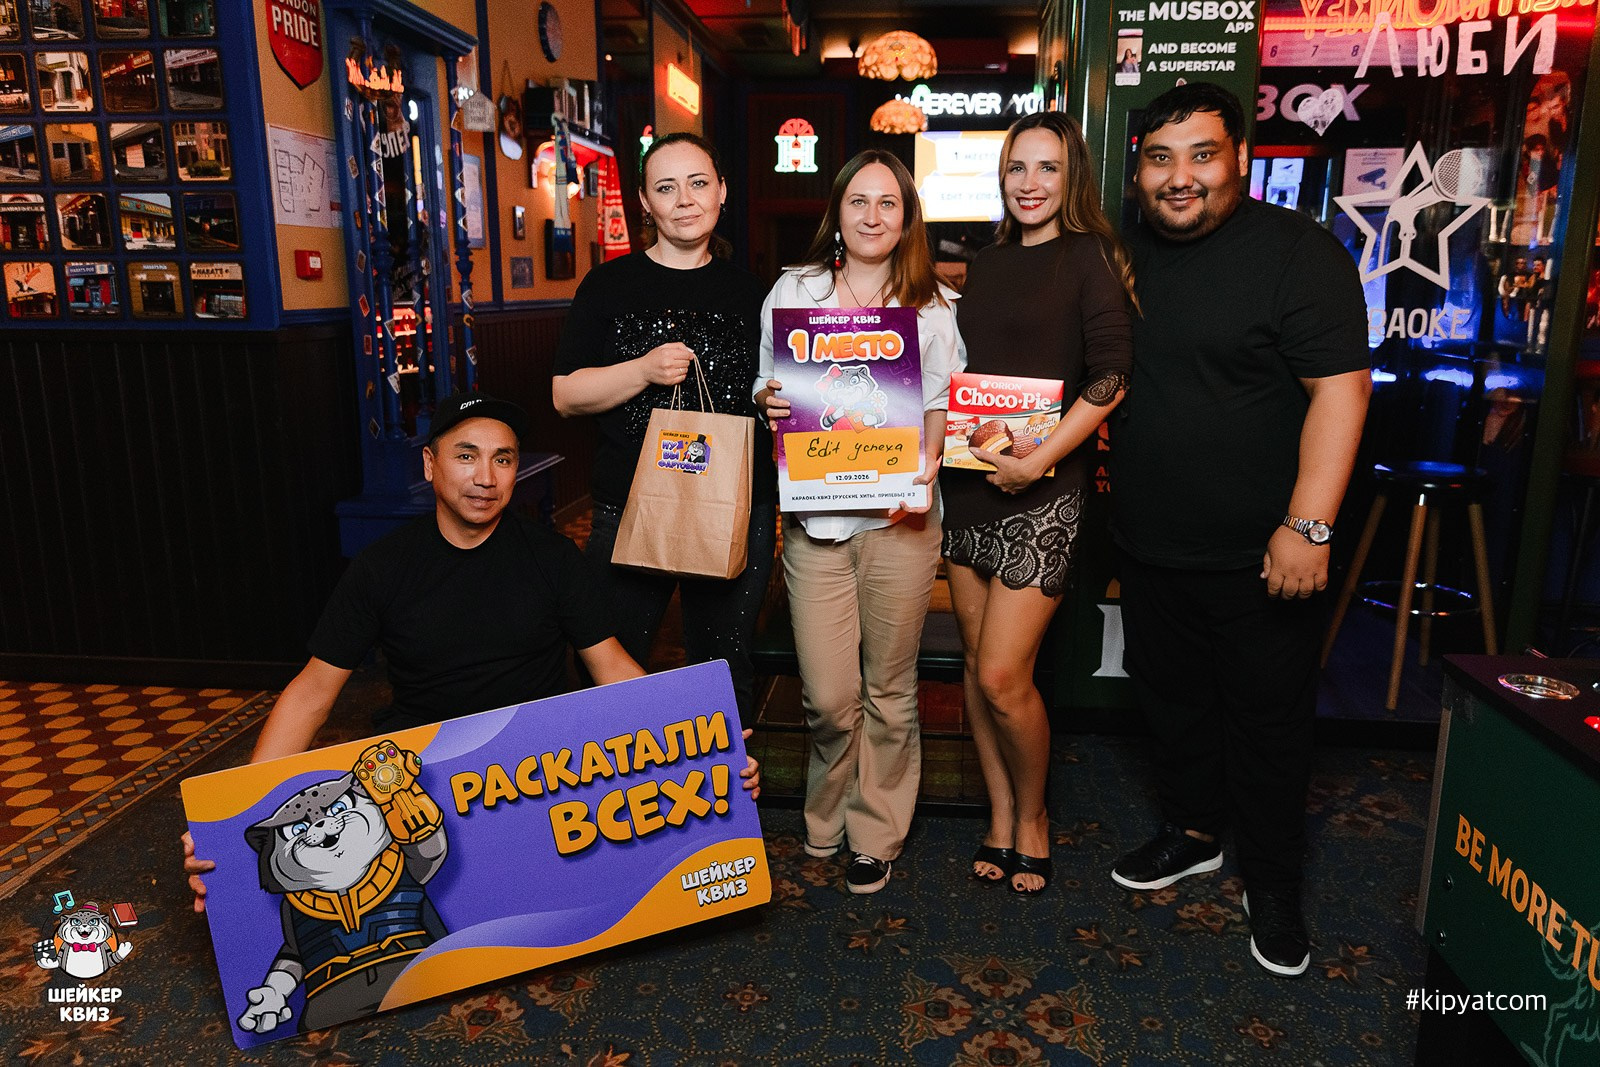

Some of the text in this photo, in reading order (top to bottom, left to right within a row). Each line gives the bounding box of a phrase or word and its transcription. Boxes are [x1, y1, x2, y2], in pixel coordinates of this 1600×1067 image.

[1118, 1, 1256, 21] THE MUSBOX
[272, 5, 319, 47] PRIDE
[1225, 22, 1254, 33] APP
[1148, 42, 1237, 54] AND BECOME
[1270, 45, 1360, 57] 6 7 8
[1354, 12, 1558, 79] ЛЮБИ
[1146, 60, 1235, 72] A SUPERSTAR
[809, 315, 881, 325] ШЕЙКЕР КВИЗ
[789, 331, 903, 361] 1 МЕСТО
[990, 382, 1023, 391] ORION
[1023, 416, 1057, 436] Original
[807, 437, 904, 461] Edit успеха
[450, 711, 731, 816] РАСКАТАЛИ
[549, 764, 731, 856] ВСЕХ!
[681, 854, 757, 891] ШЕЙКЕР
[1454, 813, 1486, 874] BE
[1487, 844, 1566, 952] MORE
[696, 878, 748, 907] КВИЗ
